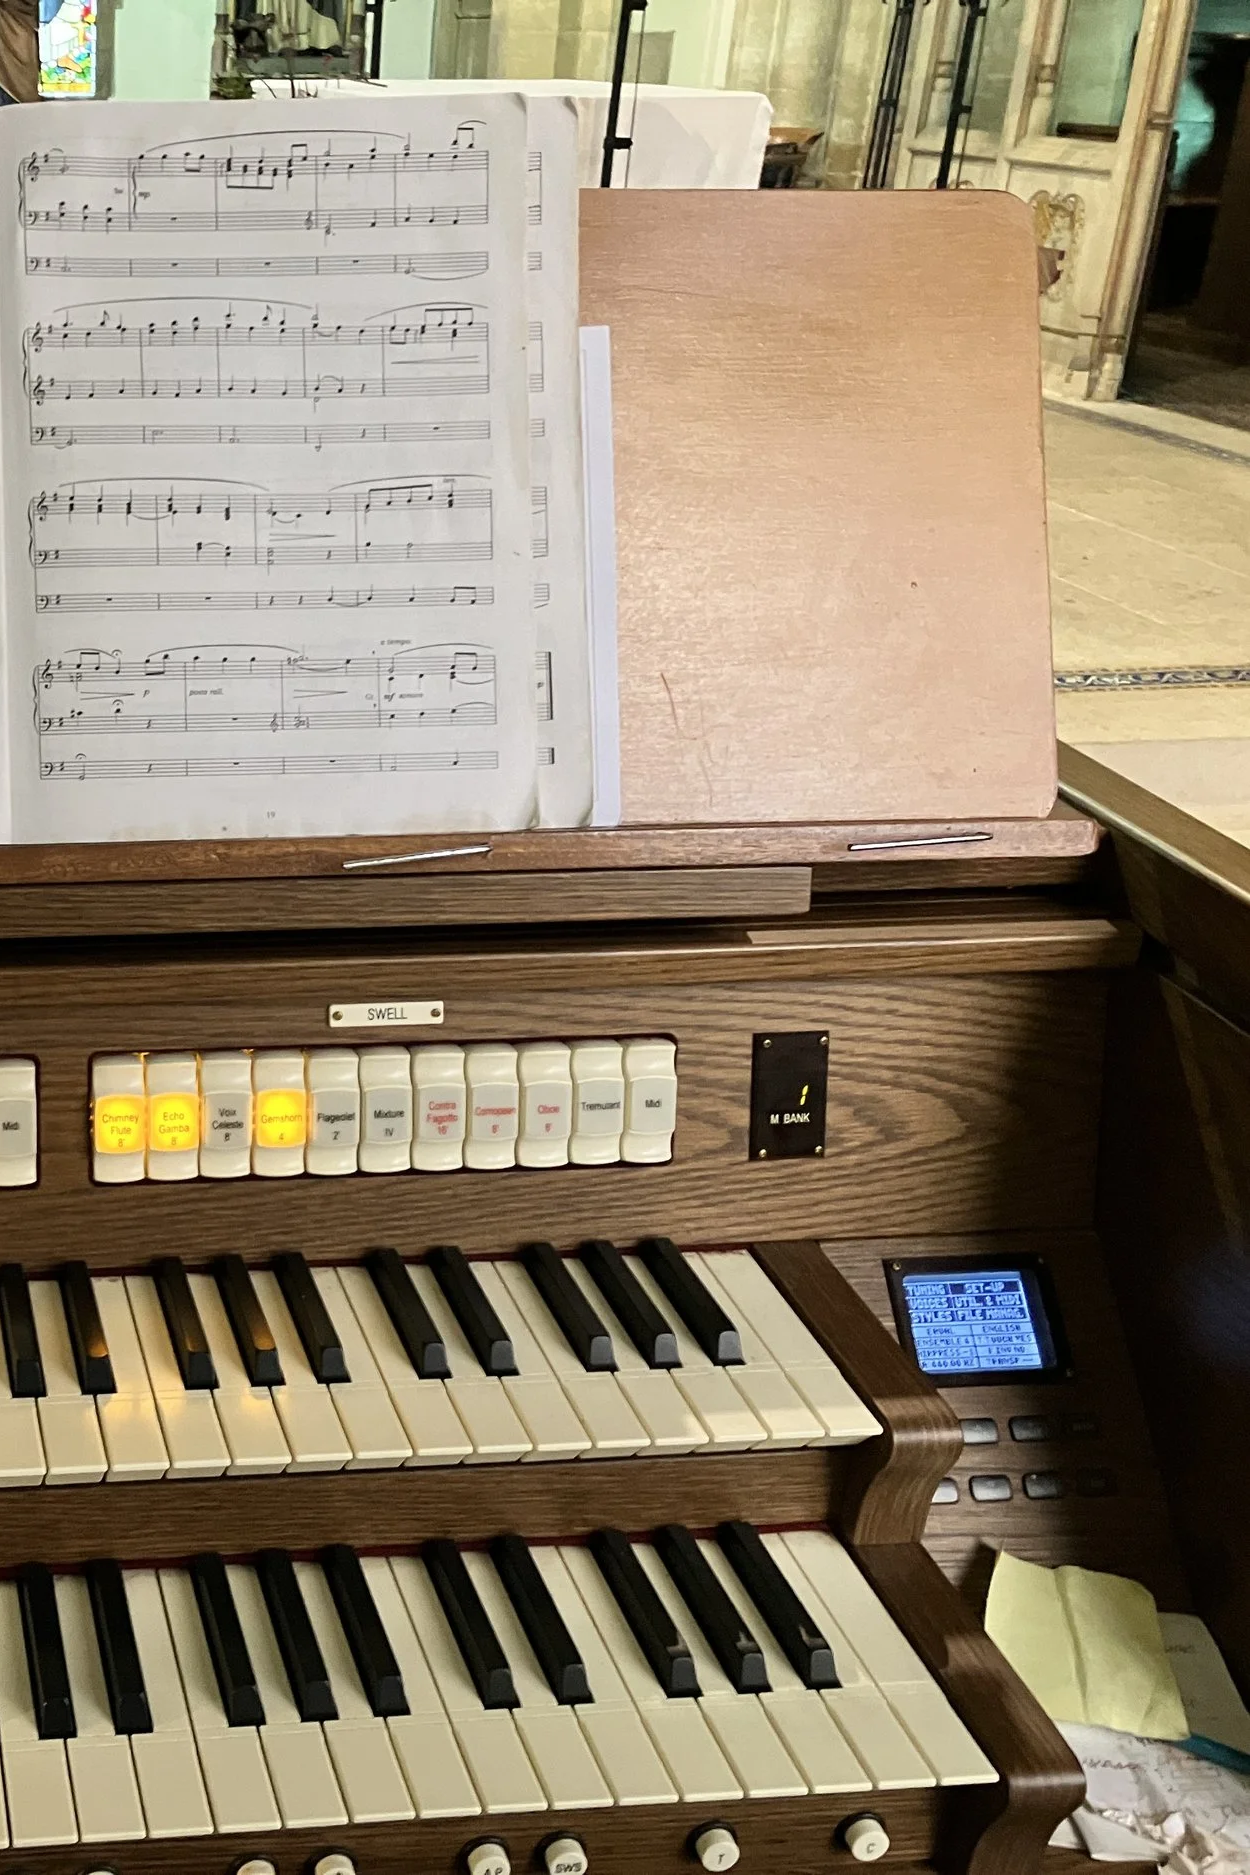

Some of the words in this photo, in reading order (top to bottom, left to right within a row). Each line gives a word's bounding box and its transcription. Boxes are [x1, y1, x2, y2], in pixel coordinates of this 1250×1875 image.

[367, 1006, 408, 1021] SWELL
[163, 1111, 185, 1122] Echo
[218, 1107, 237, 1118] Voix
[261, 1113, 303, 1124] Gemshorn
[770, 1113, 780, 1125] M
[783, 1112, 810, 1125] BANK
[102, 1112, 140, 1126] Chimney
[212, 1119, 244, 1131] Celeste
[110, 1125, 132, 1136] Flute
[158, 1122, 190, 1134] Gamba
[907, 1284, 946, 1296] TUNING
[964, 1281, 1005, 1293] SET-UP
[909, 1297, 949, 1309] VOICES
[911, 1311, 953, 1323] STYLES
[957, 1309, 983, 1321] FILE
[555, 1862, 582, 1873] SWS
